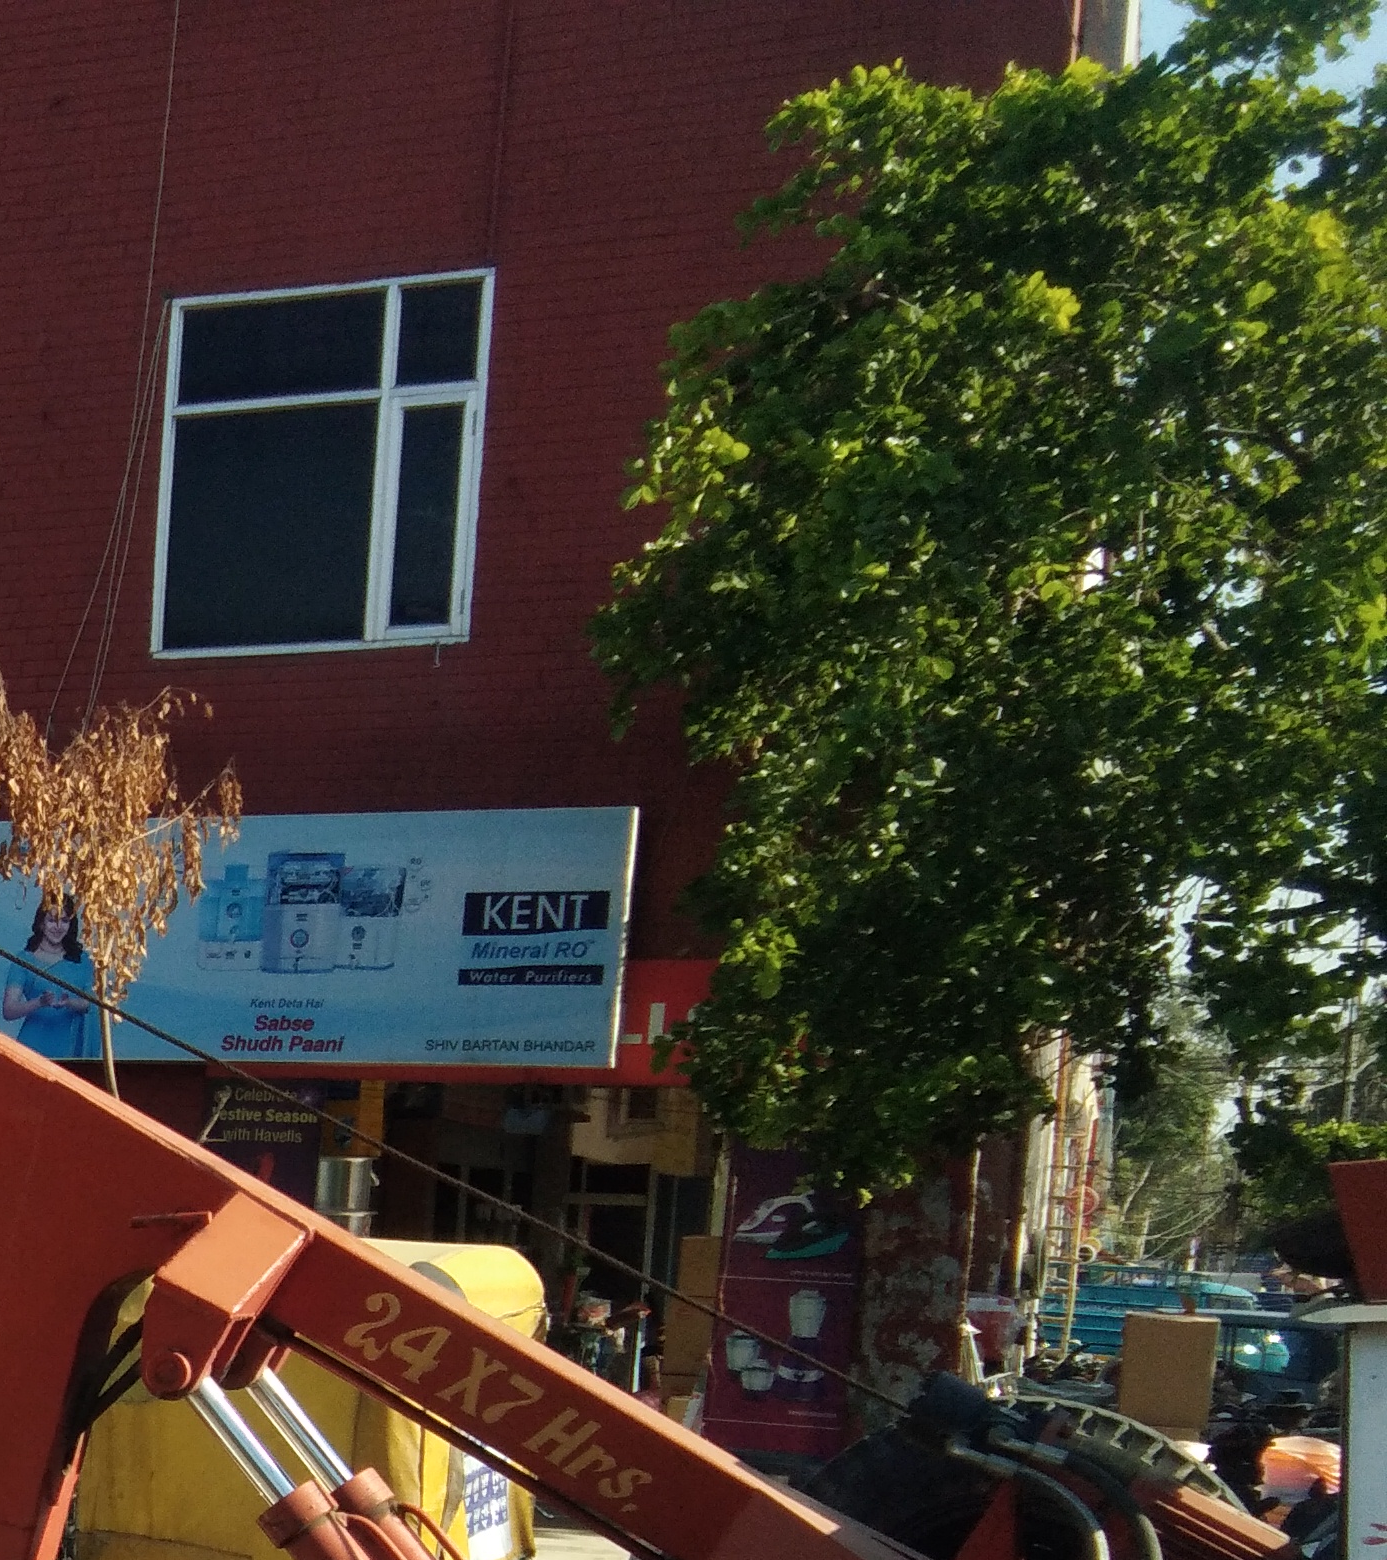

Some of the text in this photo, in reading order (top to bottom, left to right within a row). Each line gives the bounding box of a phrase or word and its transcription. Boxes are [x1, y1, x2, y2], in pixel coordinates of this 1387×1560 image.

[483, 895, 589, 930] KENT
[471, 942, 547, 959] Mineral
[469, 969, 592, 983] Water Purifiers
[249, 998, 325, 1009] Kent Deta Hai
[254, 1014, 315, 1032] Sabse
[221, 1034, 345, 1053] Shudh Paani
[425, 1039, 595, 1053] SHIV BARTAN BHANDAR
[265, 1109, 319, 1123] Season
